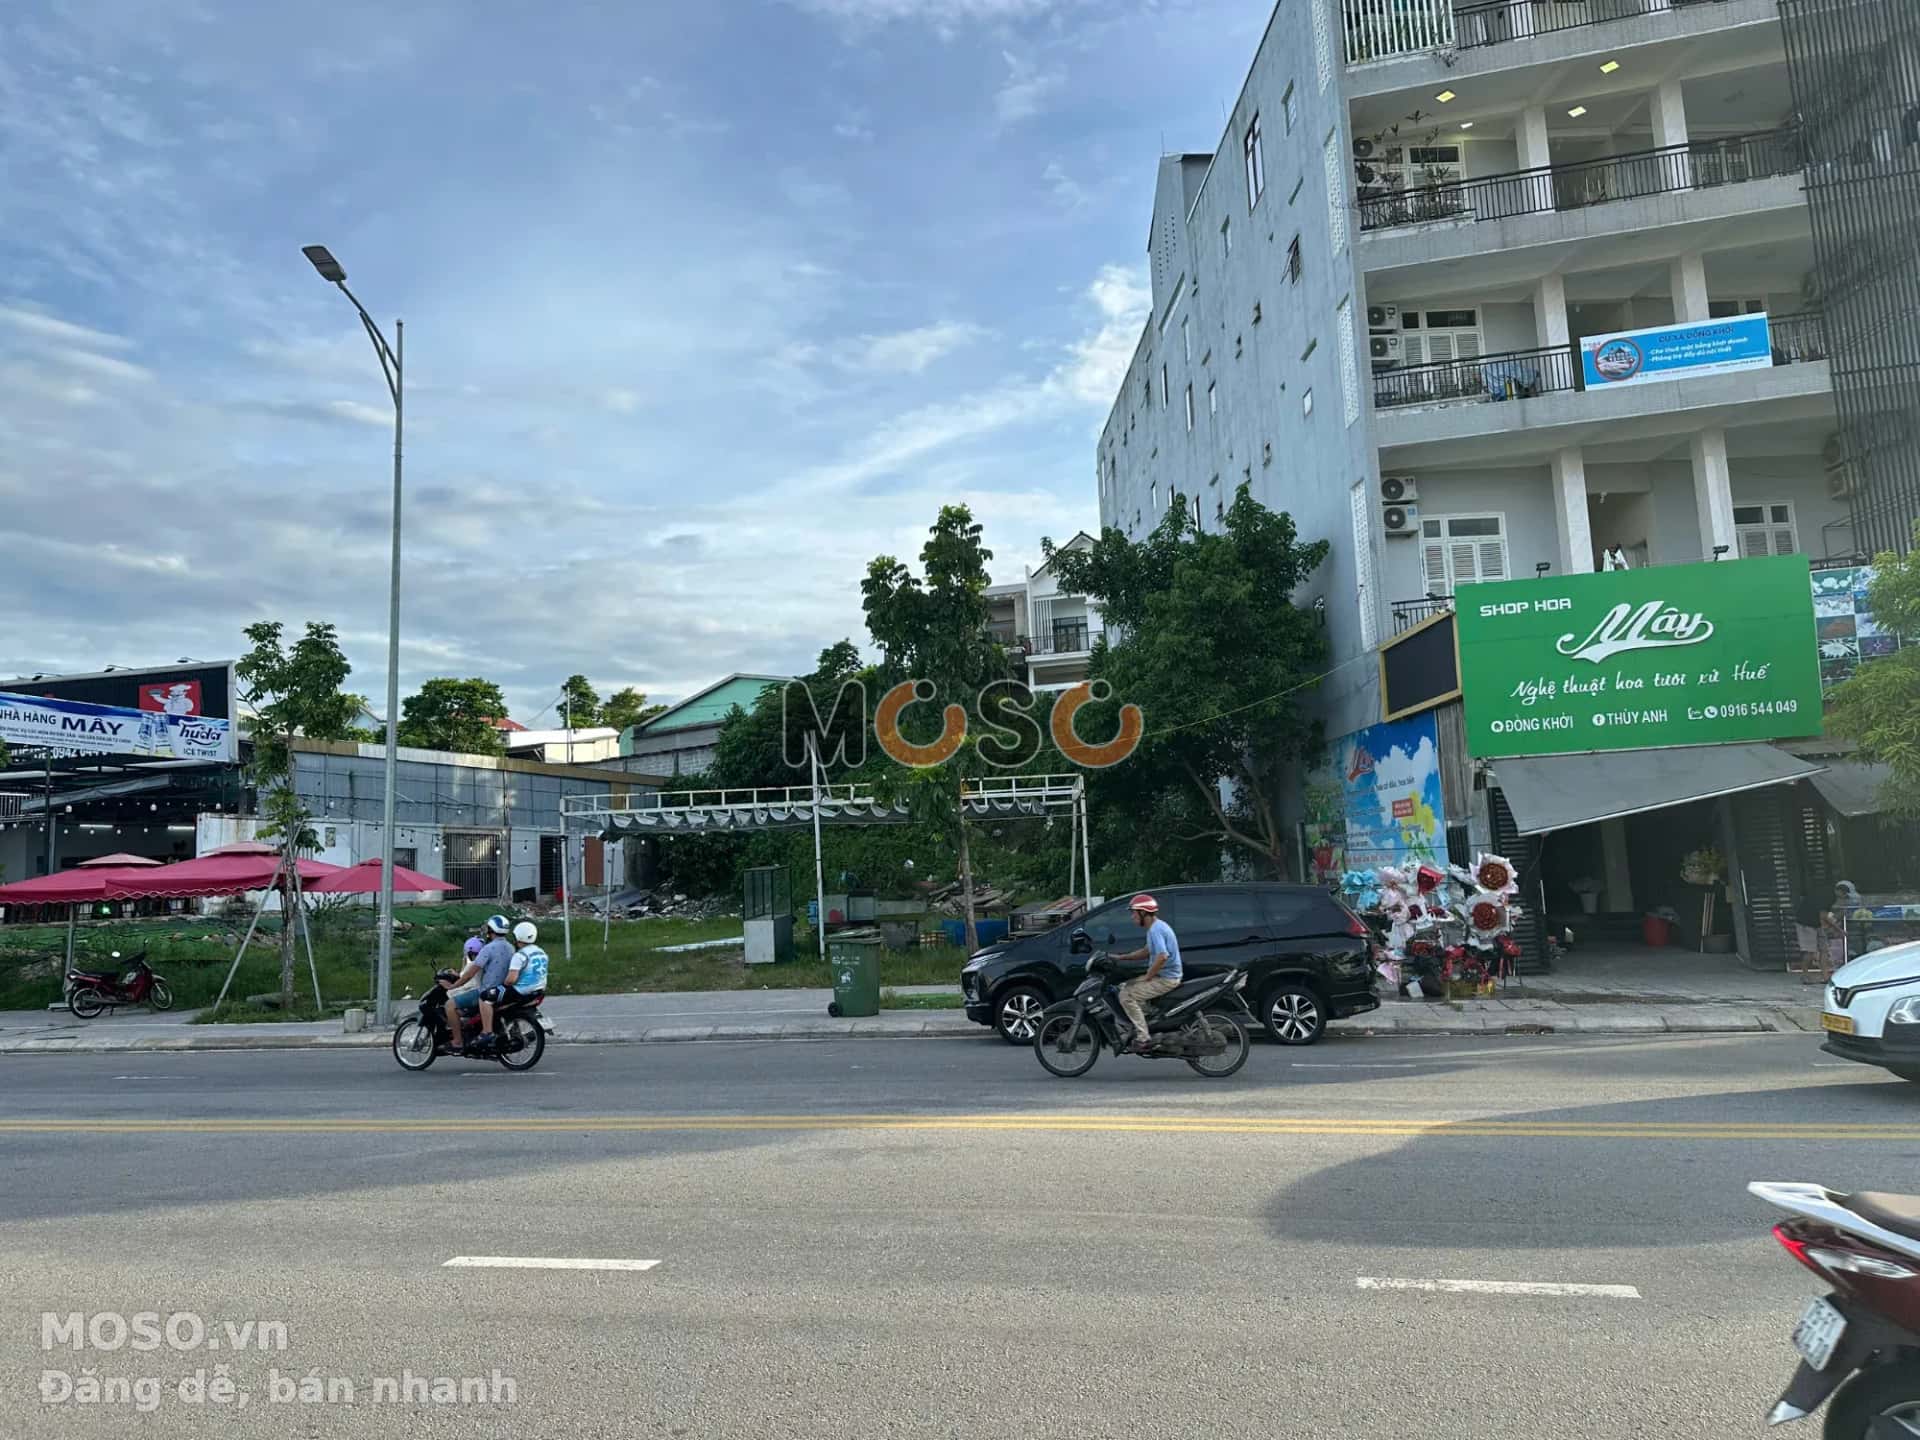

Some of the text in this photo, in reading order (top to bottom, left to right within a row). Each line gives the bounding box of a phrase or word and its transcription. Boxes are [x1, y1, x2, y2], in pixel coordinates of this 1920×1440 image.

[1480, 598, 1572, 617] SHOP HOA
[1556, 600, 1714, 664] Mây
[1510, 676, 1557, 706] Nghệ
[1562, 674, 1606, 697] thuật
[1615, 671, 1644, 690] hoa
[1732, 660, 1771, 681] Huế
[1641, 709, 1668, 724] ANH
[1720, 699, 1798, 718] 0916 544 049
[24, 711, 57, 725] HÀNG
[61, 717, 124, 736] MÂY
